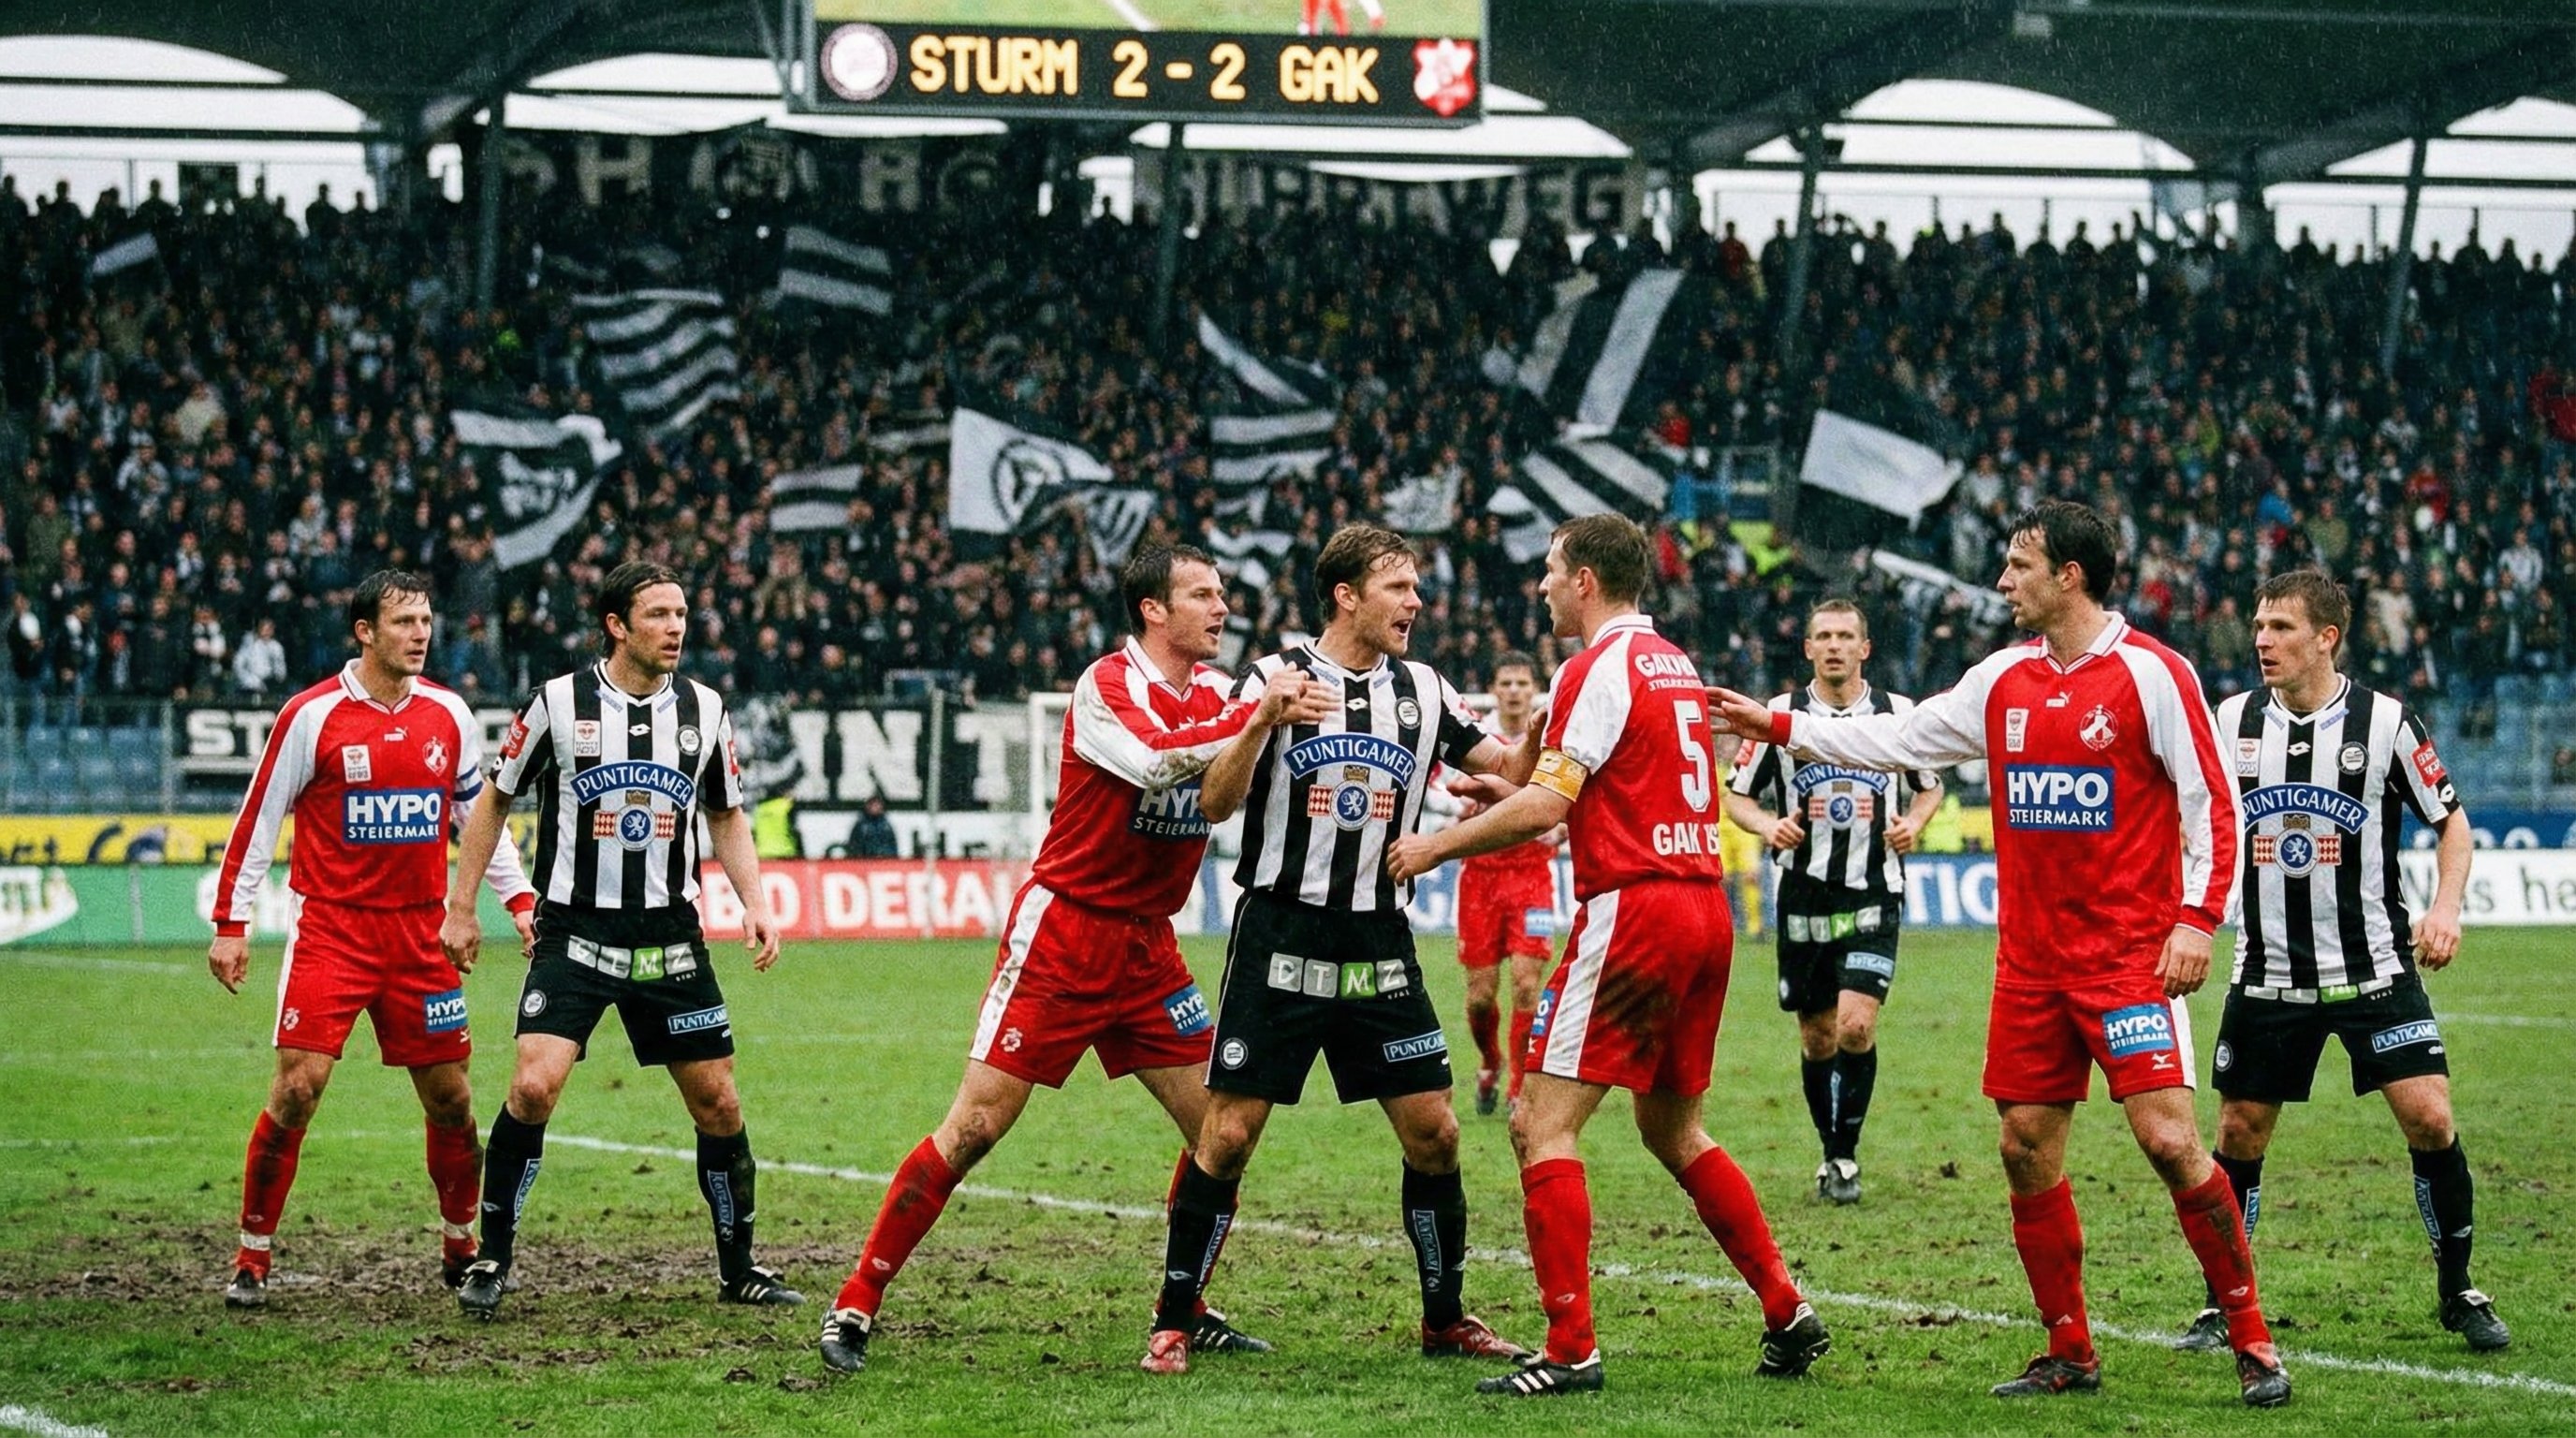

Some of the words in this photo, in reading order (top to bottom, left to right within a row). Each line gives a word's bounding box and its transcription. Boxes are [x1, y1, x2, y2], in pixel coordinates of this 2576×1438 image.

[910, 34, 1078, 95] STURM
[1112, 40, 1148, 97] 2
[1164, 62, 1193, 80] -
[1210, 43, 1246, 100] 2
[1279, 44, 1379, 104] GAK
[788, 710, 922, 801] IN
[1295, 738, 1414, 783] PUNTIGAMER
[1673, 700, 1711, 813] 5
[577, 766, 692, 804] PUNTIGAMER
[1138, 787, 1205, 818] HYP
[2008, 771, 2109, 807] HYPO
[348, 793, 441, 824] HYPO
[2010, 809, 2107, 826] STEIERMARK
[2244, 788, 2362, 827] PUNTIGAMER
[1653, 822, 1703, 857] GAK
[2107, 1013, 2168, 1040] HYPO
